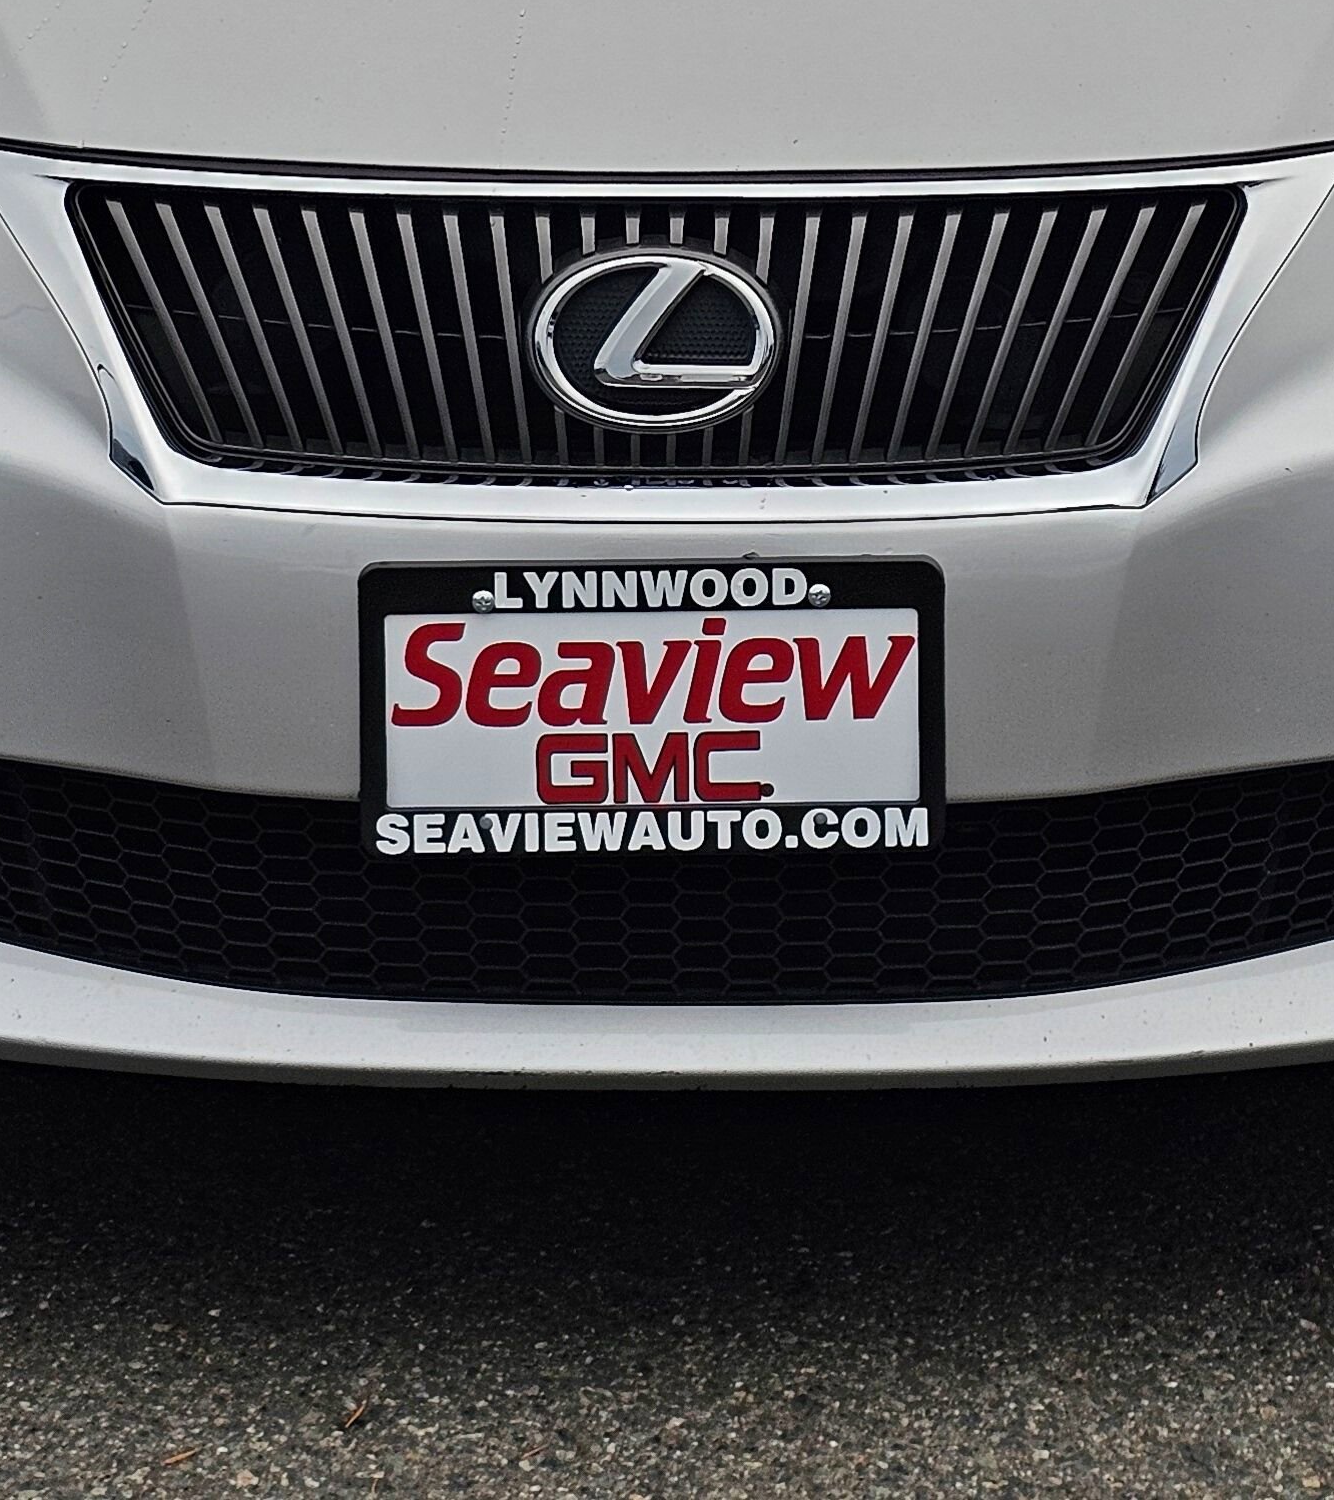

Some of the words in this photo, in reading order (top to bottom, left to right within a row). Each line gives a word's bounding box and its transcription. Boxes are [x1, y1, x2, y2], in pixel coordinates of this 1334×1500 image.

[493, 568, 809, 609] LYNNWOOD
[390, 617, 916, 728] Seaview
[535, 730, 775, 805] GMC
[375, 806, 930, 855] SEAVIEWAUTO.COM
